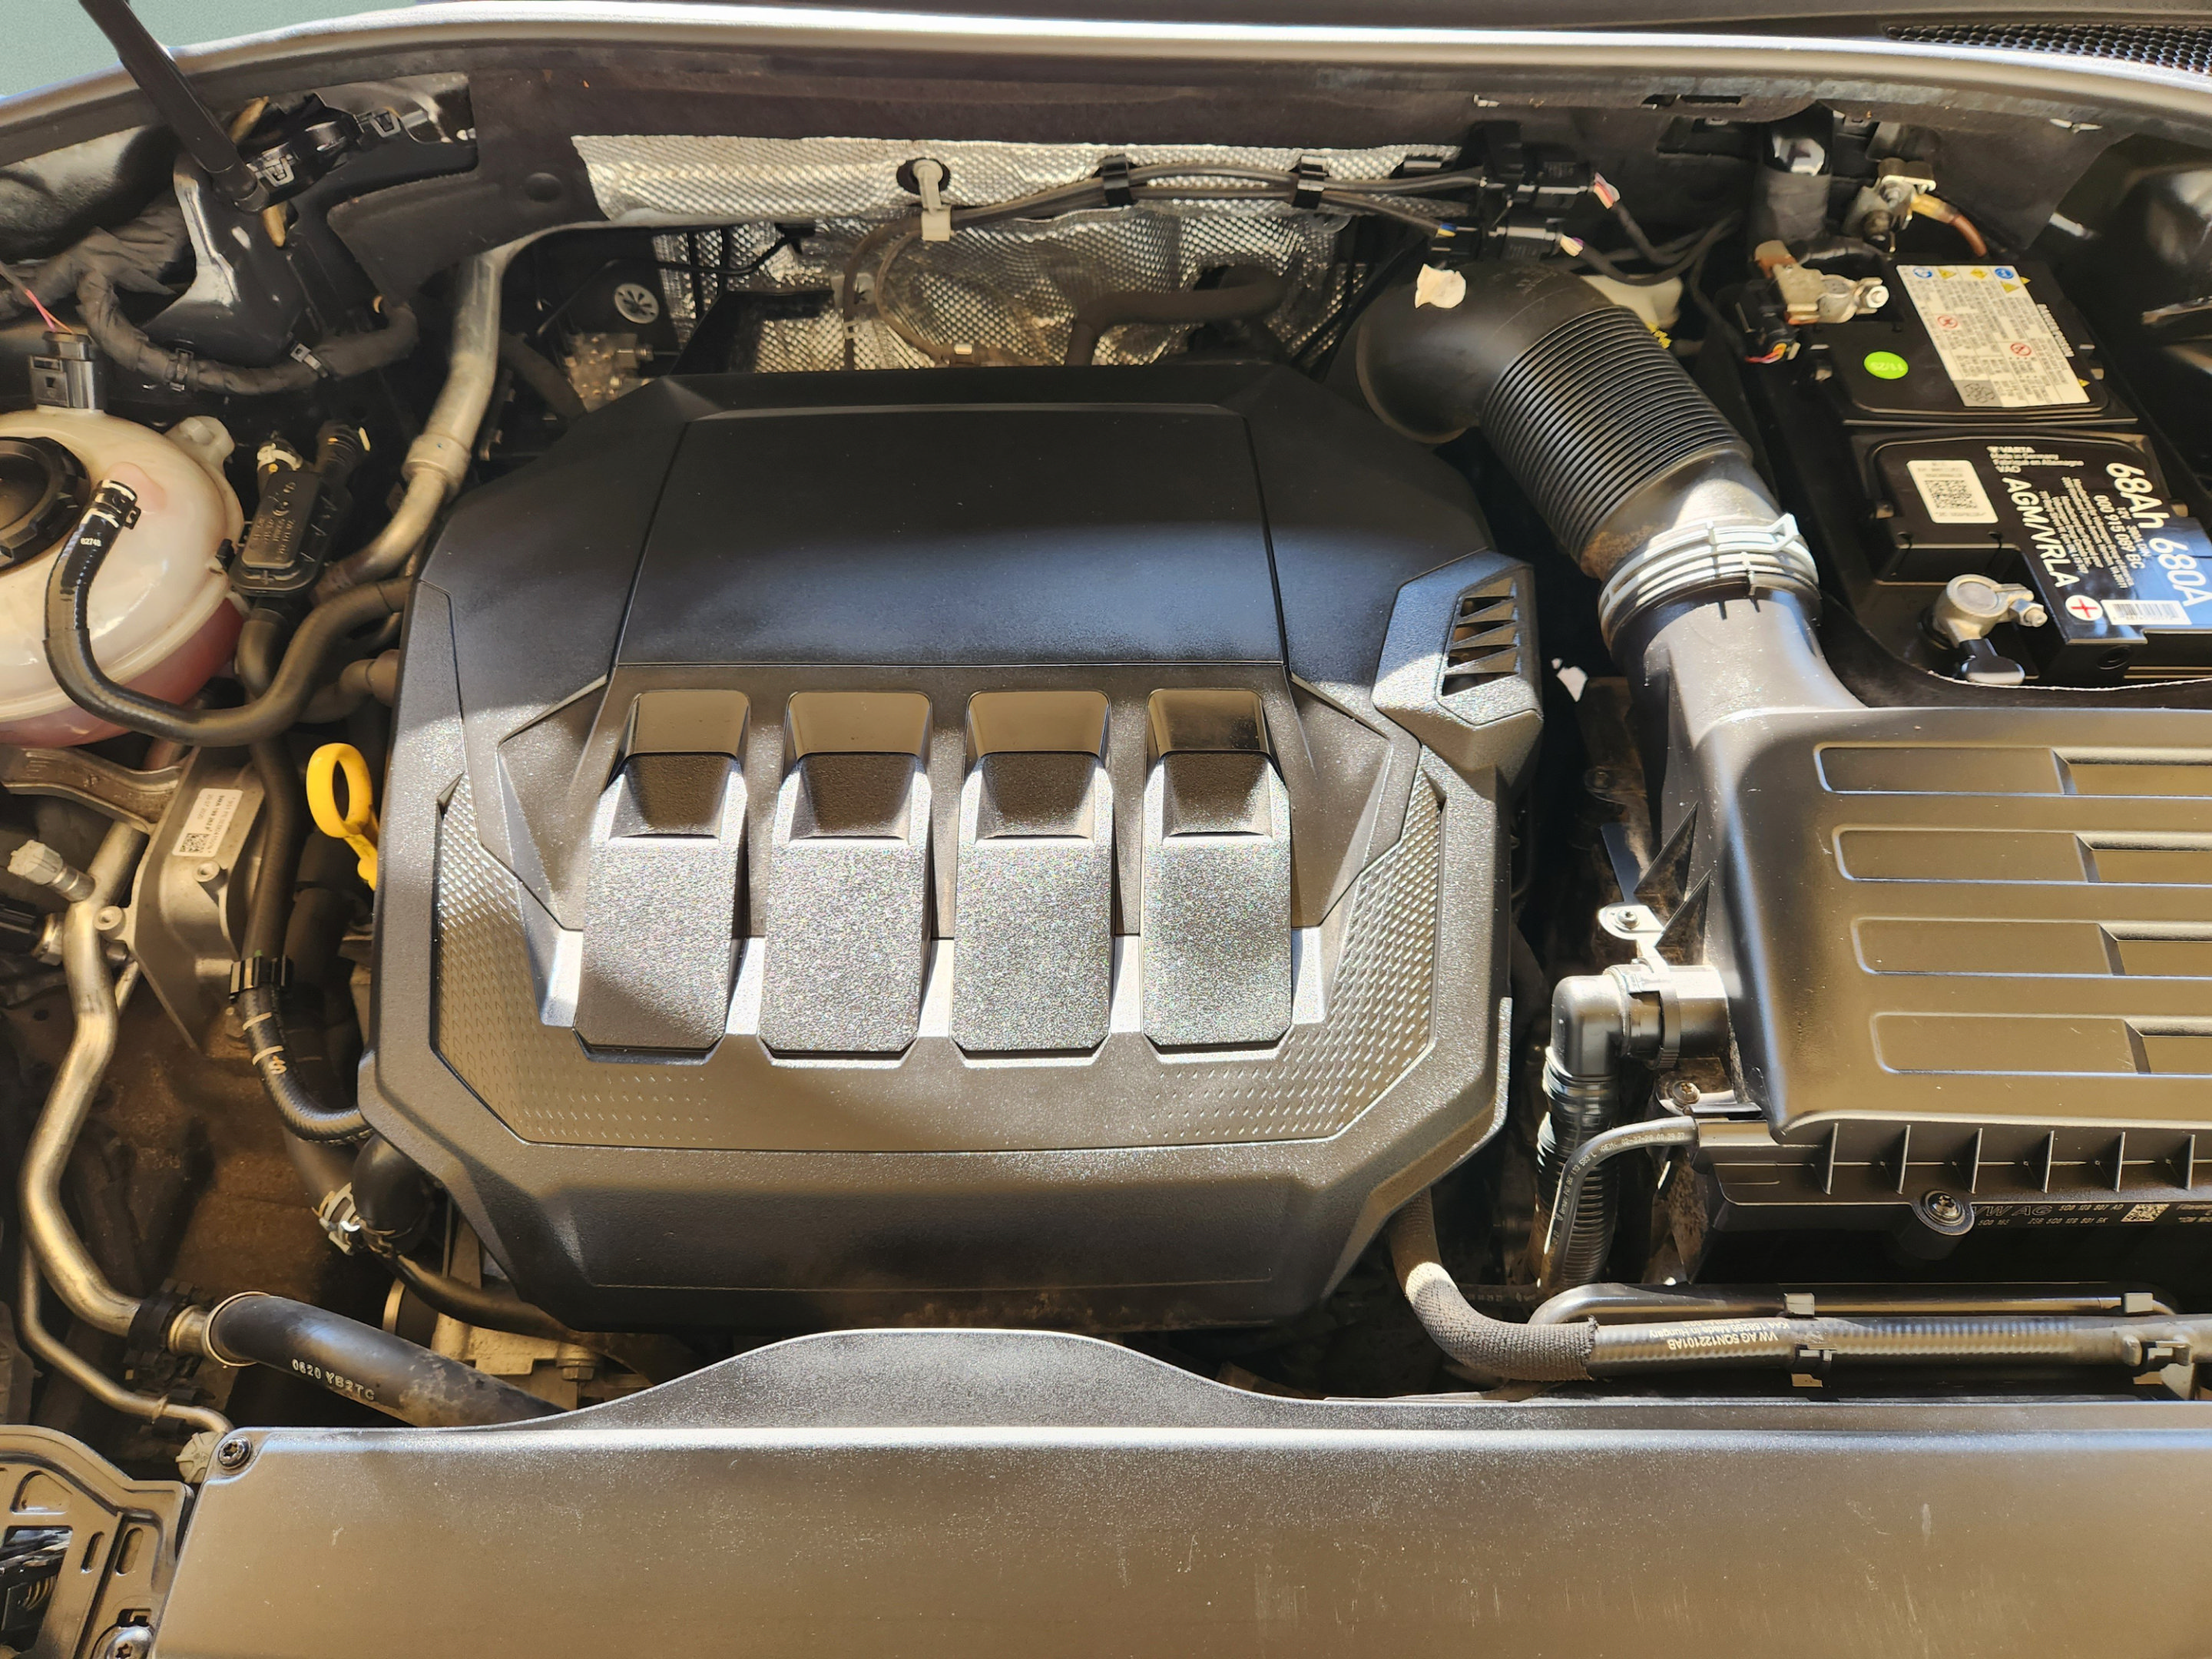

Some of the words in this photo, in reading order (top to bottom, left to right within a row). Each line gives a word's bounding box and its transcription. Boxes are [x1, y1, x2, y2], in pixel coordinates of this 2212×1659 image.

[2093, 495, 2115, 514] 000
[2116, 506, 2132, 520] 12V
[2104, 514, 2126, 532] 915
[2106, 462, 2171, 529] 68Ah
[2149, 538, 2212, 607] 680A
[2114, 533, 2137, 552] 089
[2124, 554, 2146, 569] BC
[1973, 1206, 2012, 1217] VW
[2012, 1205, 2053, 1217] AG
[1649, 1327, 1692, 1339] Hungary
[1692, 1326, 1701, 1335] in
[1701, 1325, 1730, 1334] Made
[1759, 1331, 1779, 1342] VW
[1667, 1334, 1741, 1350] 5QN122101AB
[1741, 1333, 1758, 1343] AG
[292, 1358, 321, 1379] 0620
[325, 1370, 376, 1401] YB2TC
